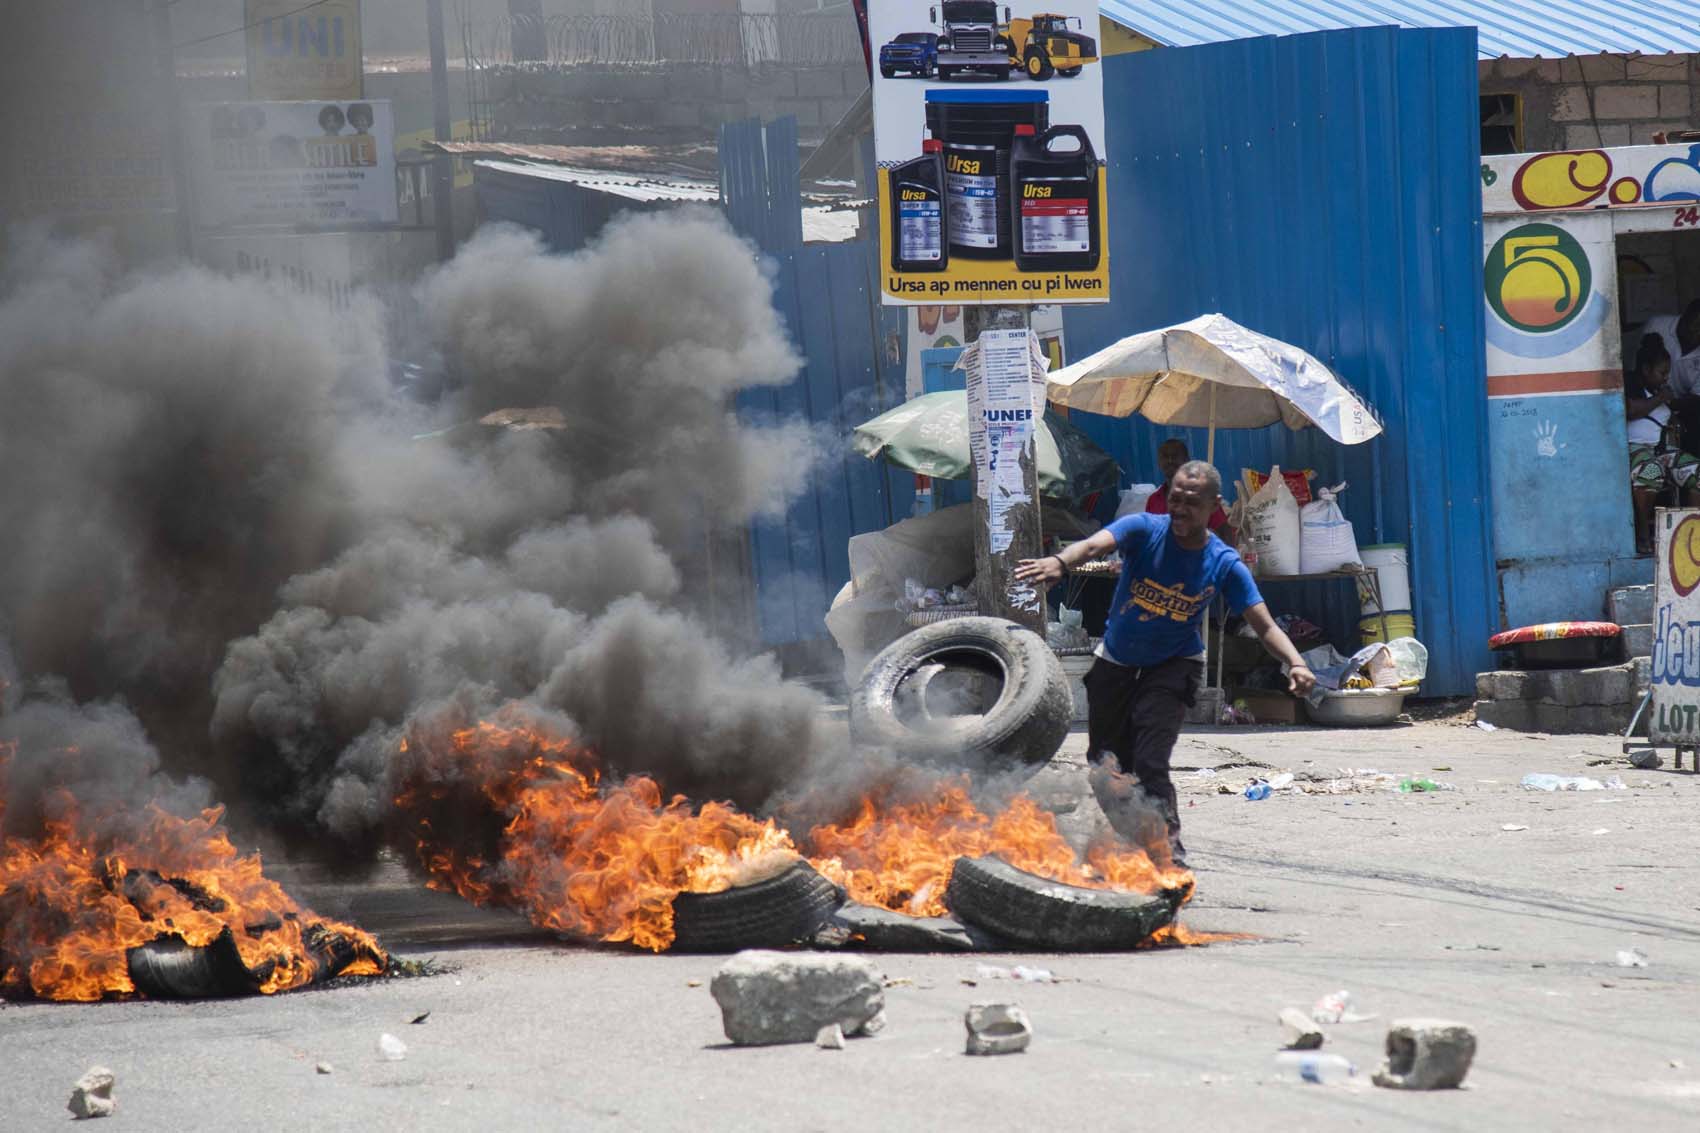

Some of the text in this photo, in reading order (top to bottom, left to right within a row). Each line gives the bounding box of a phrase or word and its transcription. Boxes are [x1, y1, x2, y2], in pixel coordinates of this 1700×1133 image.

[263, 15, 344, 57] UNI
[947, 154, 981, 174] Ursa
[901, 190, 927, 200] Ursa
[1023, 183, 1052, 198] Ursa
[889, 275, 1102, 295] Ursa ap mennen ou pi lwen
[1659, 703, 1700, 733] LOT
